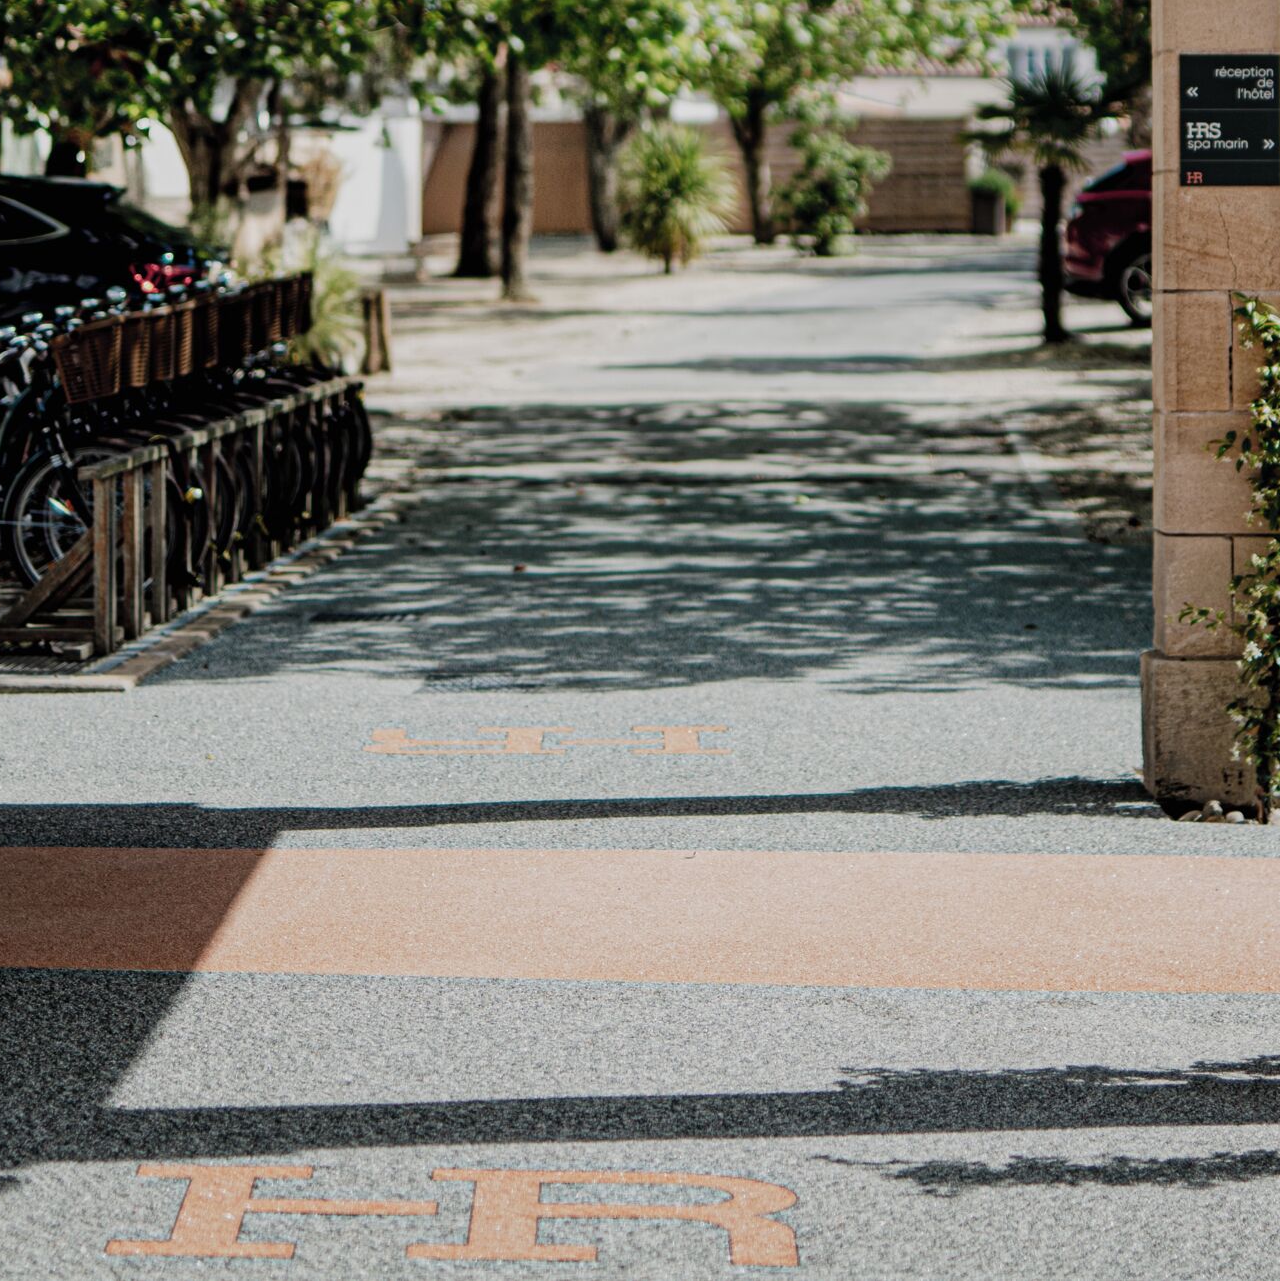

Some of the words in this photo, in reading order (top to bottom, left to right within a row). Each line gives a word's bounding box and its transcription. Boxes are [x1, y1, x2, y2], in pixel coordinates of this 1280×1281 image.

[1214, 66, 1274, 80] réception
[1256, 77, 1274, 88] de
[1237, 87, 1275, 99] l'hôtel
[1186, 122, 1222, 139] HRS
[1187, 139, 1211, 151] spa
[1214, 137, 1249, 149] marin
[1186, 171, 1203, 184] HR
[105, 1164, 799, 1267] HR
